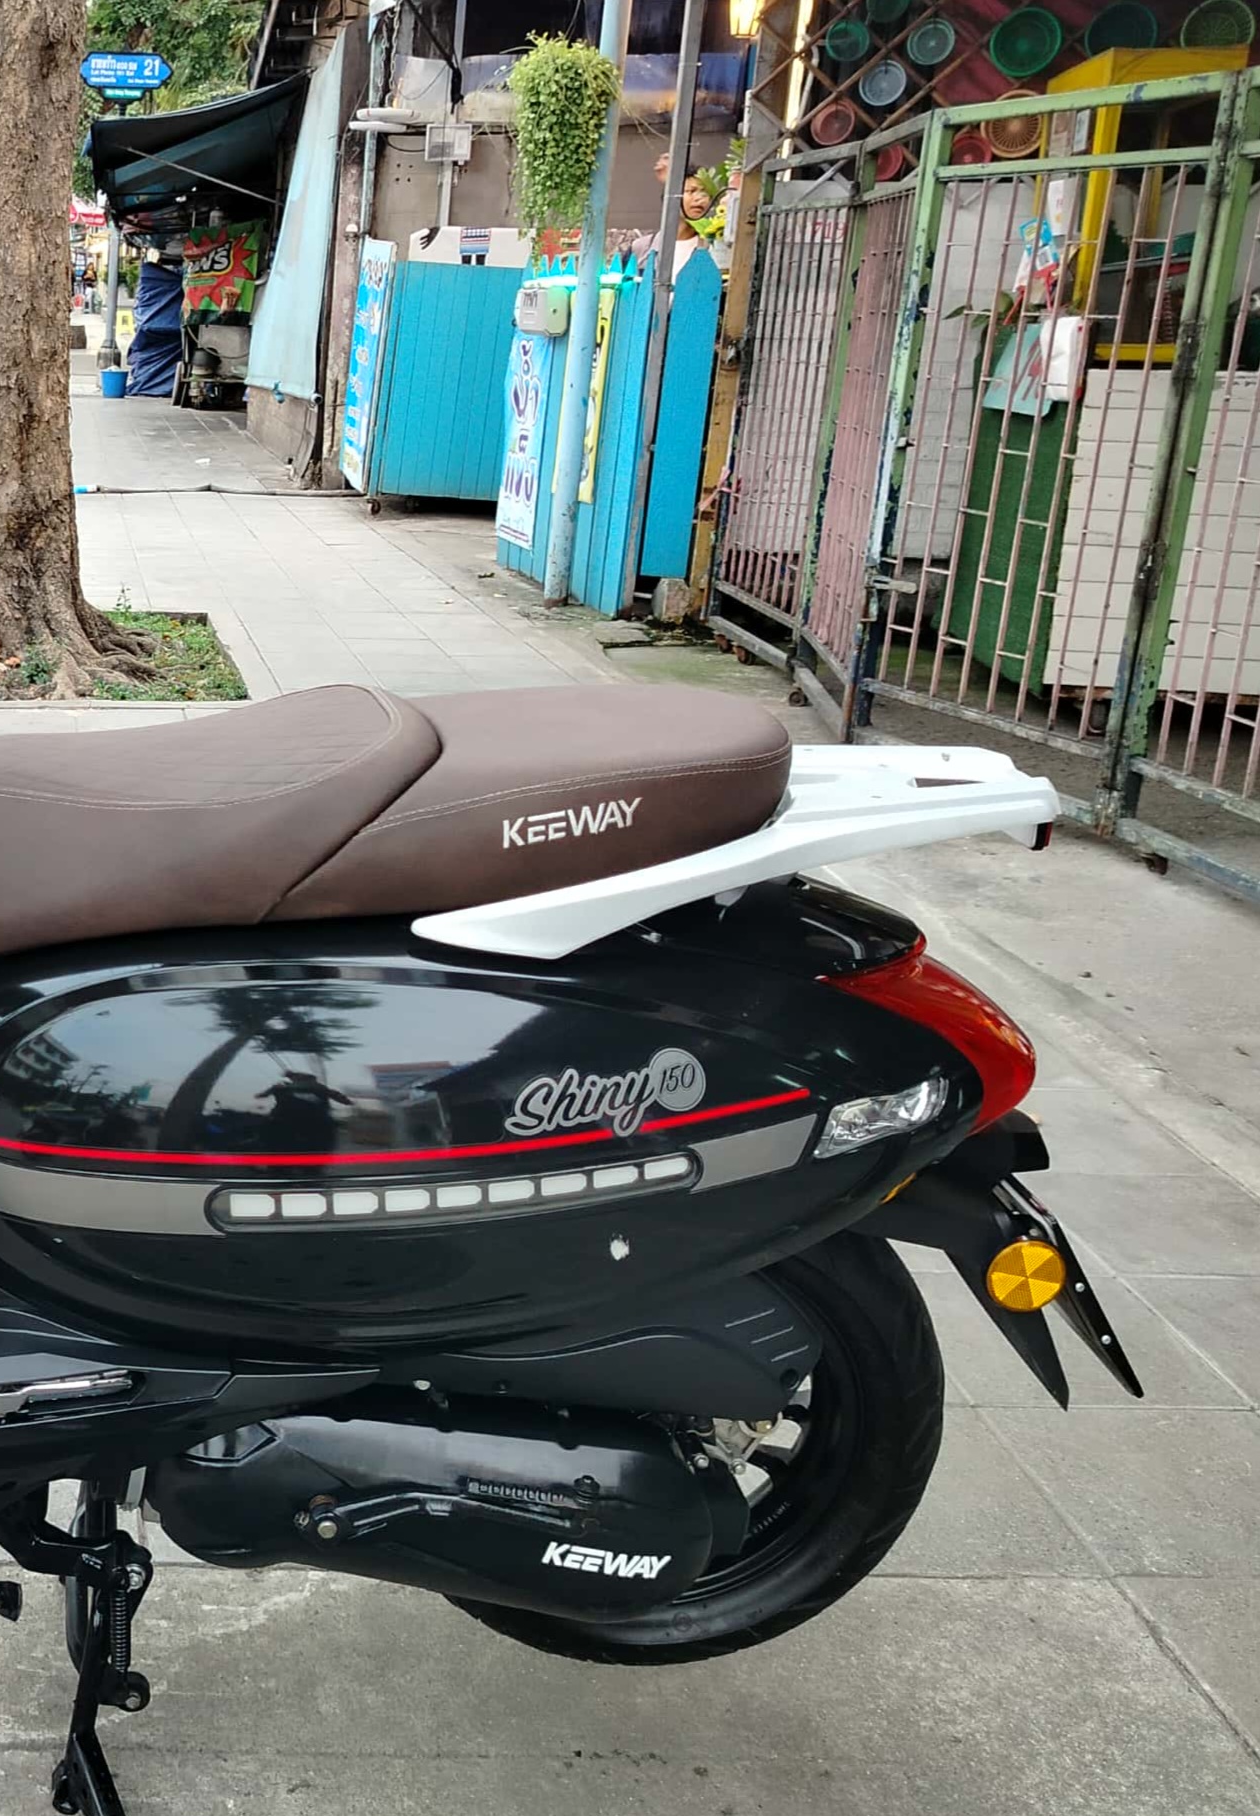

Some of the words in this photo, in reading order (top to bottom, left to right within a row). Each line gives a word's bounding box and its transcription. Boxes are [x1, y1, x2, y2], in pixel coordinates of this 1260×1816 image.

[143, 58, 160, 77] 21
[502, 797, 643, 849] KEEWAY
[505, 1068, 654, 1136] Shiny
[659, 1062, 696, 1095] 150
[541, 1541, 672, 1580] KEEWAY
